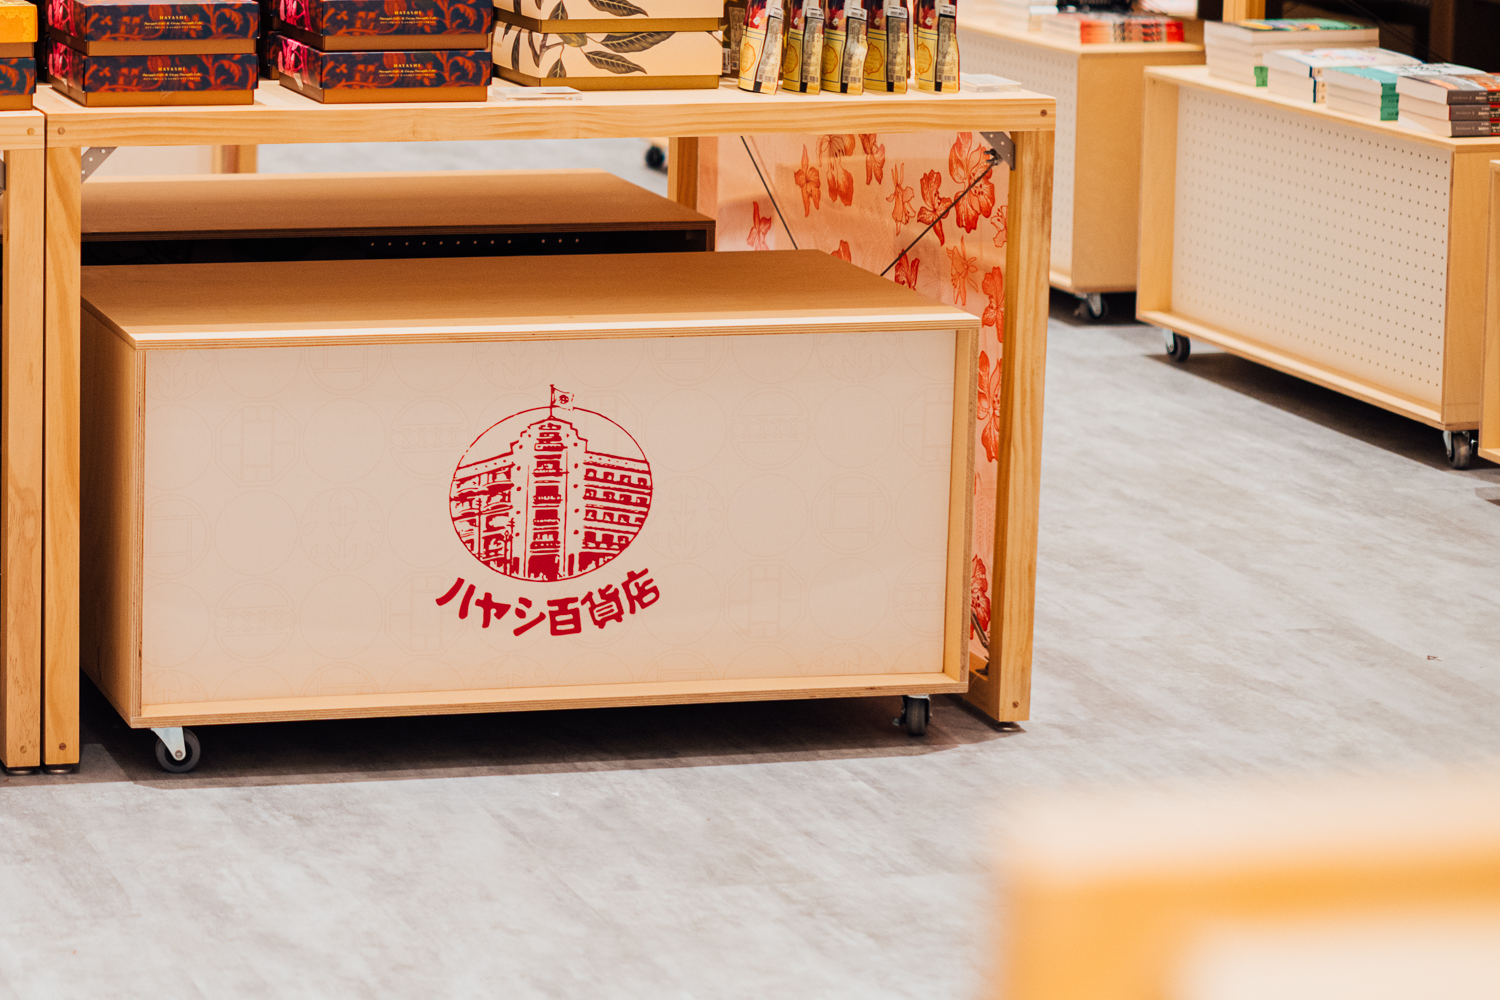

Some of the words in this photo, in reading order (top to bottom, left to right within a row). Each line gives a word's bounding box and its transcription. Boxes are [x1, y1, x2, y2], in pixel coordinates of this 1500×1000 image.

[435, 567, 661, 637] ハヤシ百貨店
